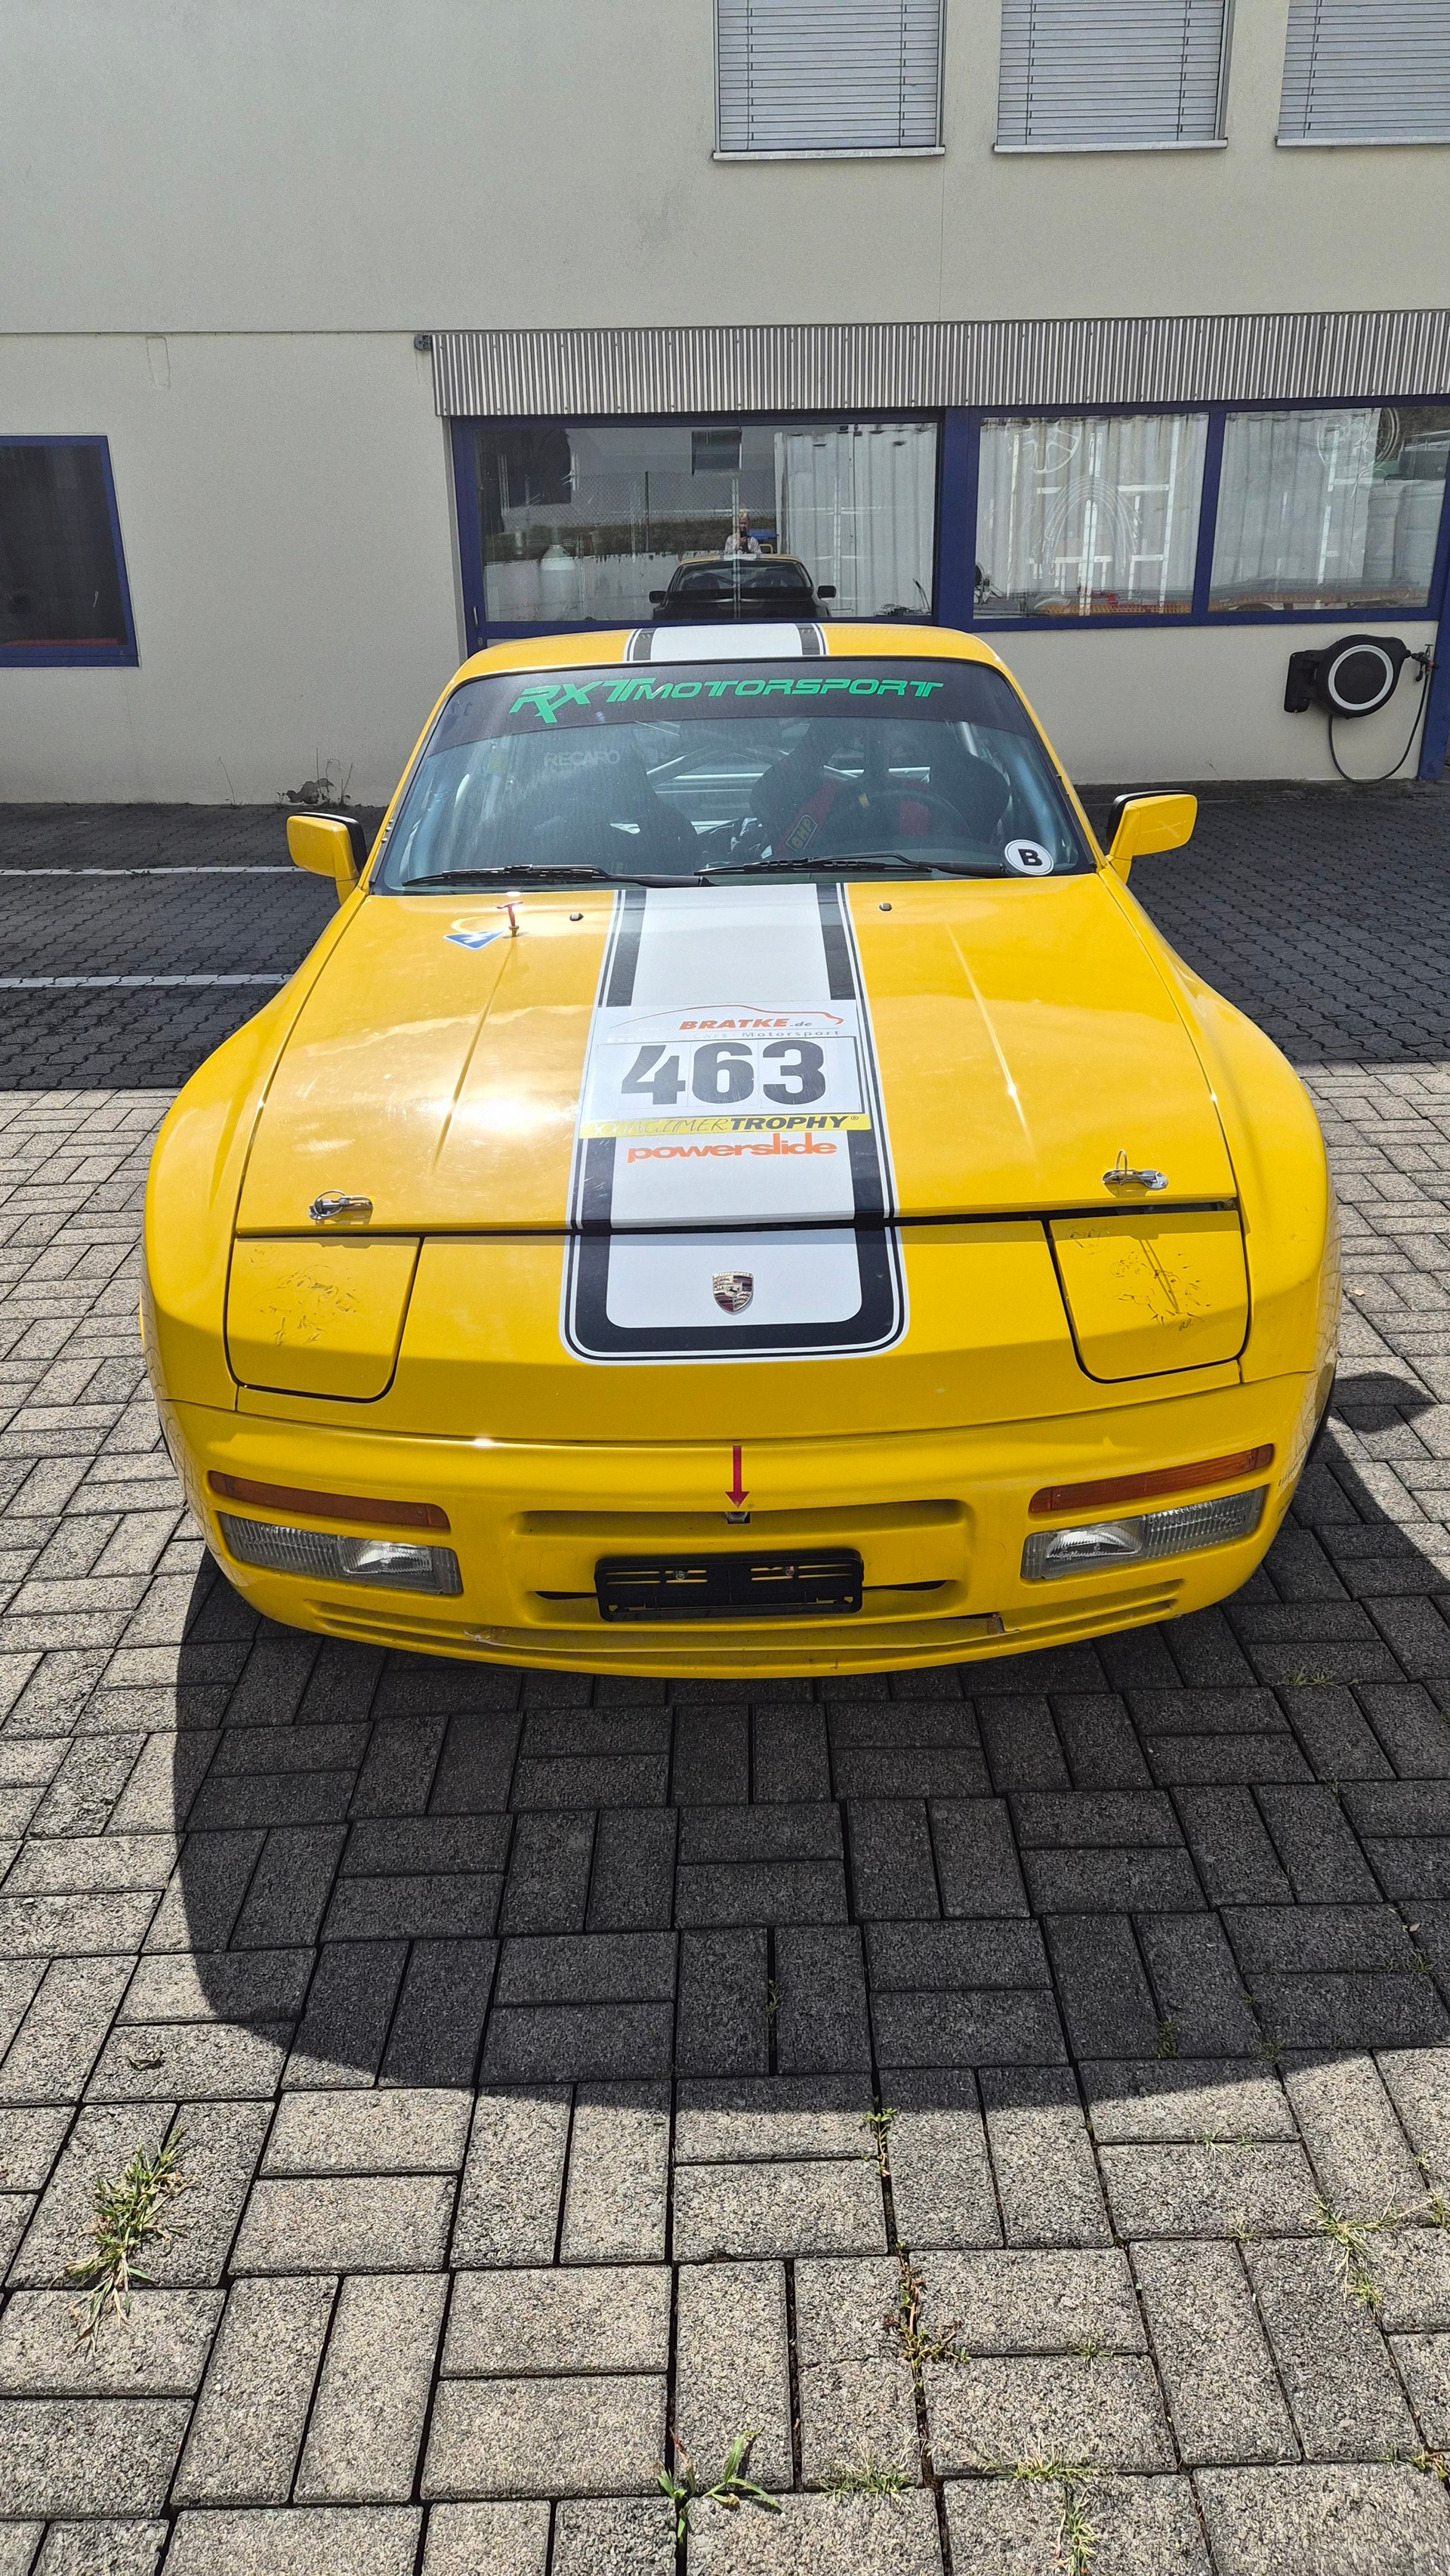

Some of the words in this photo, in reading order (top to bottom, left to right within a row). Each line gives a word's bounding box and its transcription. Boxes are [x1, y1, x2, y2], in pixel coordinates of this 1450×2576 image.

[544, 749, 621, 767] RECARO
[1017, 848, 1044, 866] B
[742, 1029, 840, 1038] Motorsport
[621, 1039, 826, 1105] 463
[627, 1133, 838, 1163] powerslide
